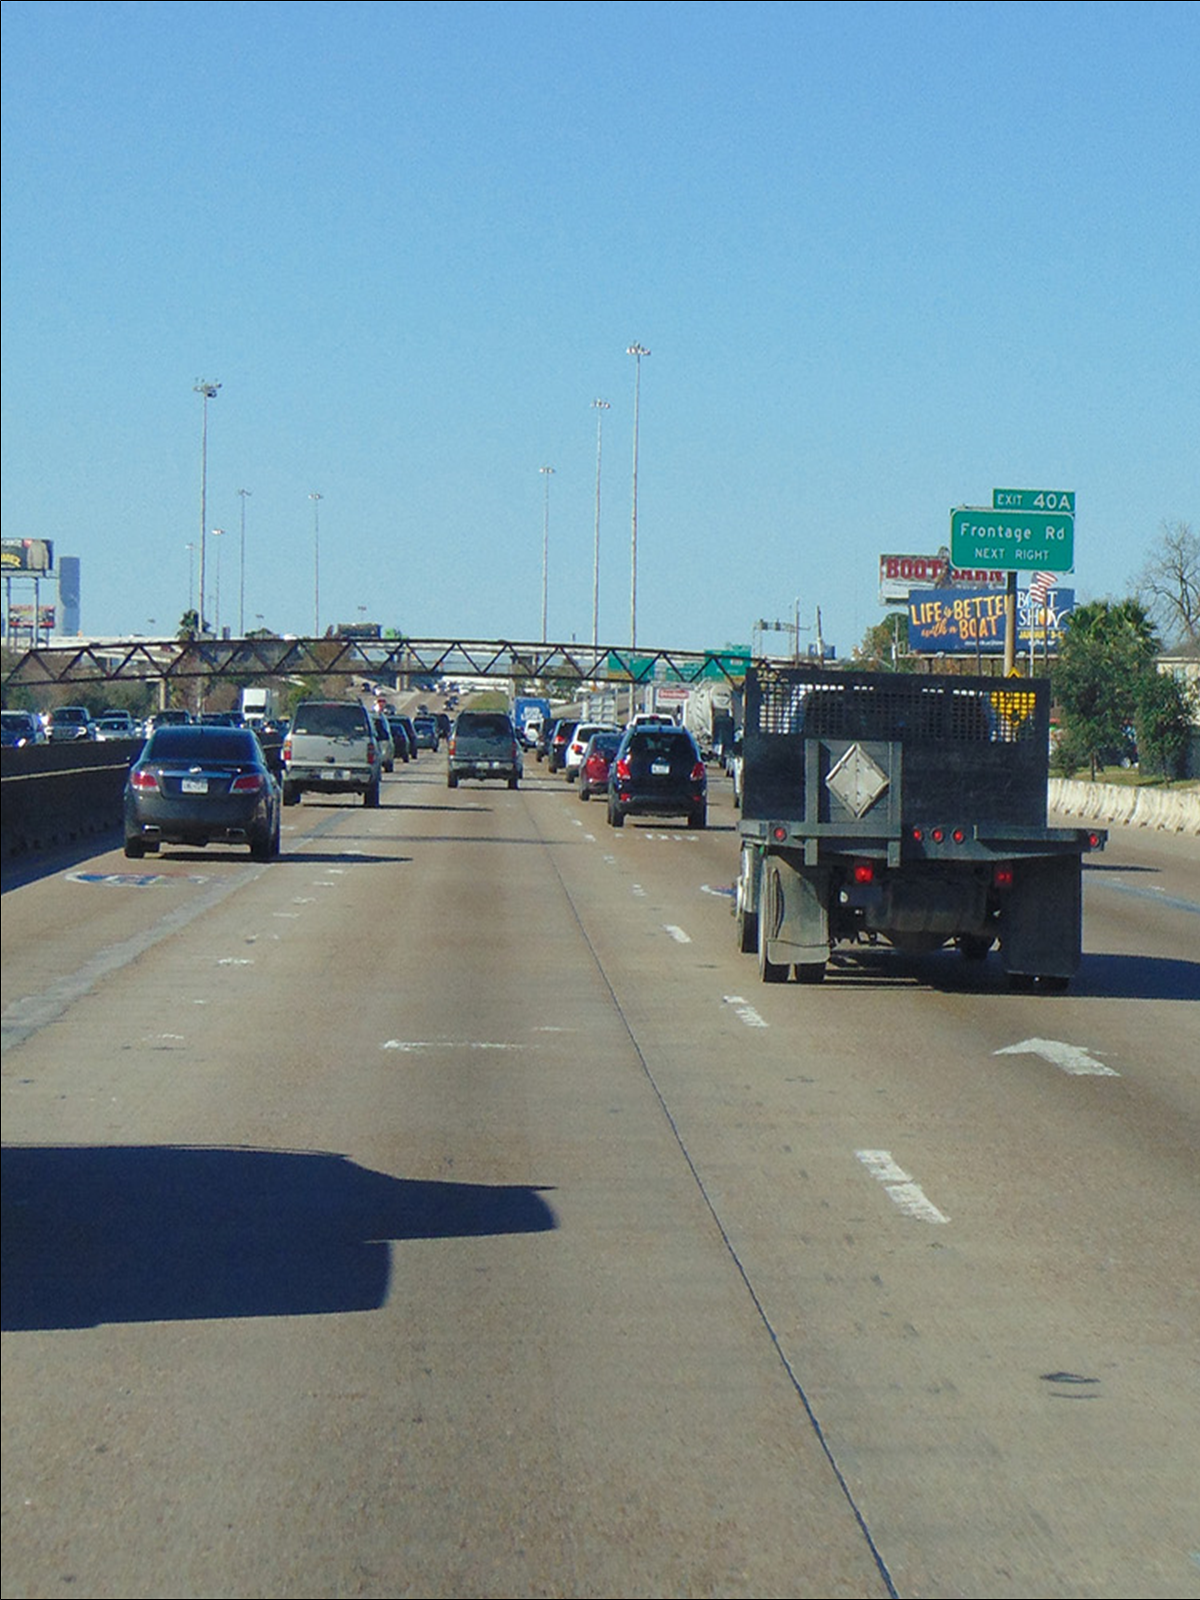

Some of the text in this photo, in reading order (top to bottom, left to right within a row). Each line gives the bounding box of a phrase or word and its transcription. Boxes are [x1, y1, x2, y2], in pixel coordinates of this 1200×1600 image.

[997, 493, 1071, 510] EXIT 40A
[960, 522, 1065, 543] Frontage Rd
[974, 547, 1050, 560] NEXT RIGHT
[886, 558, 943, 579] BOOT
[911, 602, 942, 625] LIFE
[959, 616, 998, 640] BOAT
